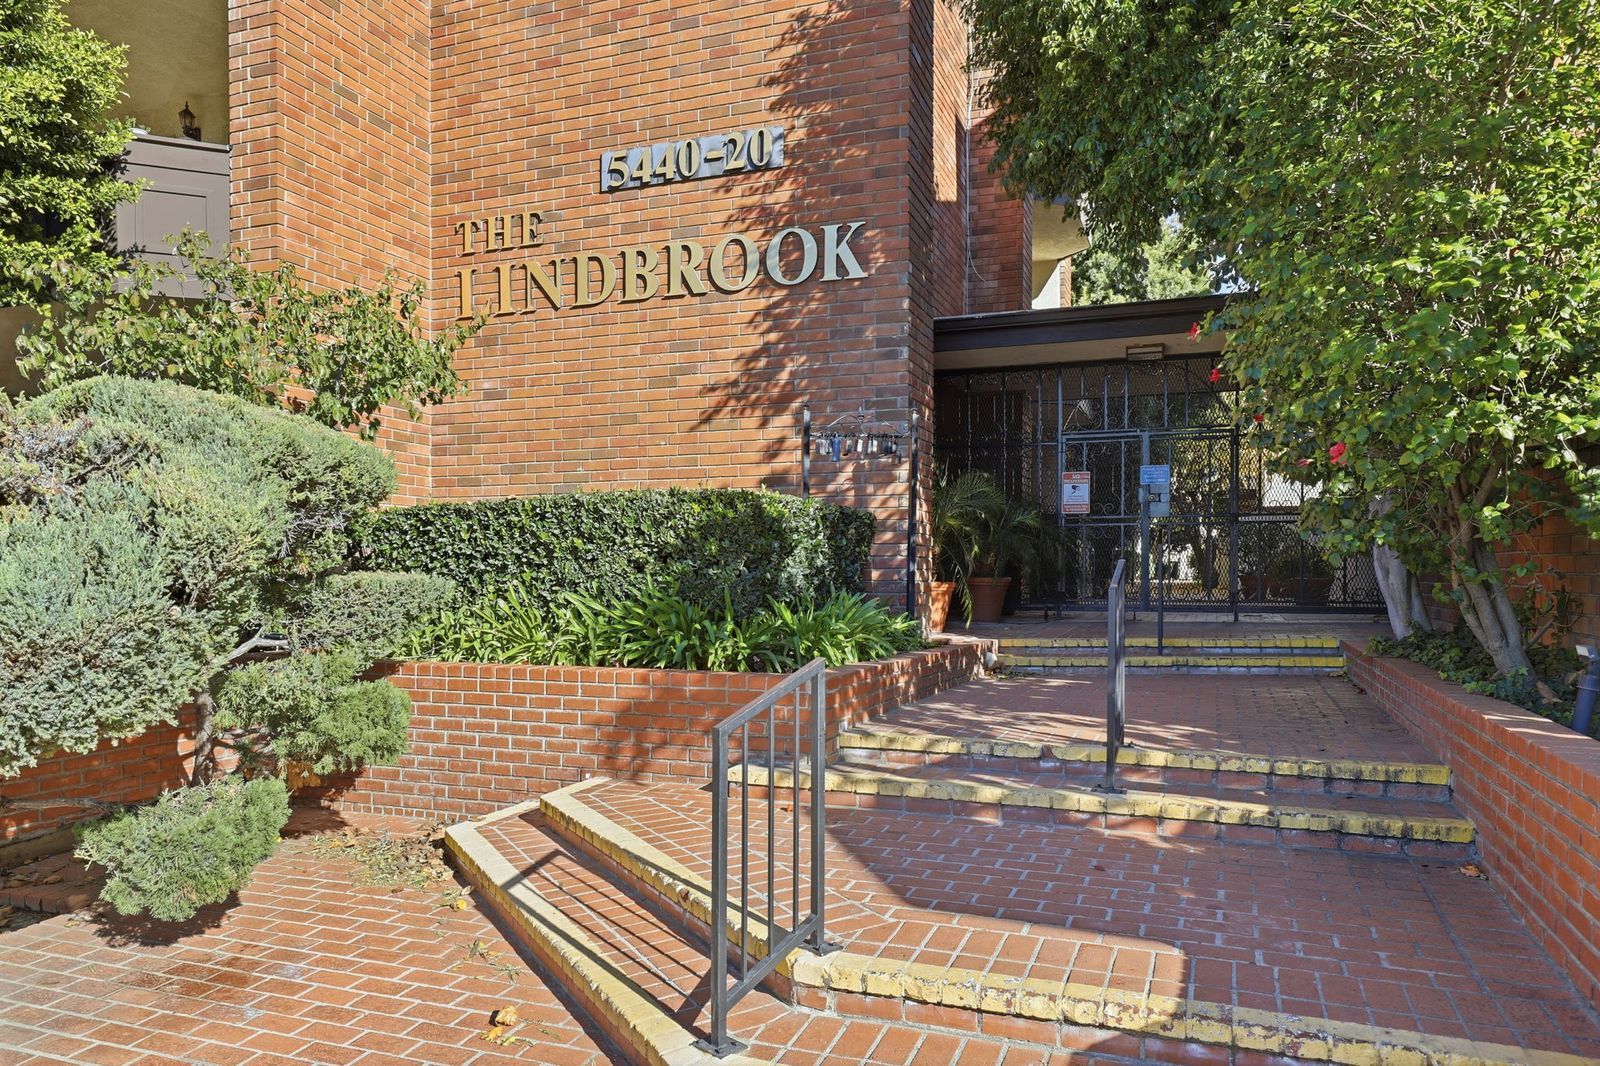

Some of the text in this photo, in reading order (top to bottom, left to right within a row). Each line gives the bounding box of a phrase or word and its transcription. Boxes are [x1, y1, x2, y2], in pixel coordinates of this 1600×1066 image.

[607, 128, 773, 188] 5440-20
[455, 211, 544, 256] THE
[456, 221, 869, 320] LINDBROOK
